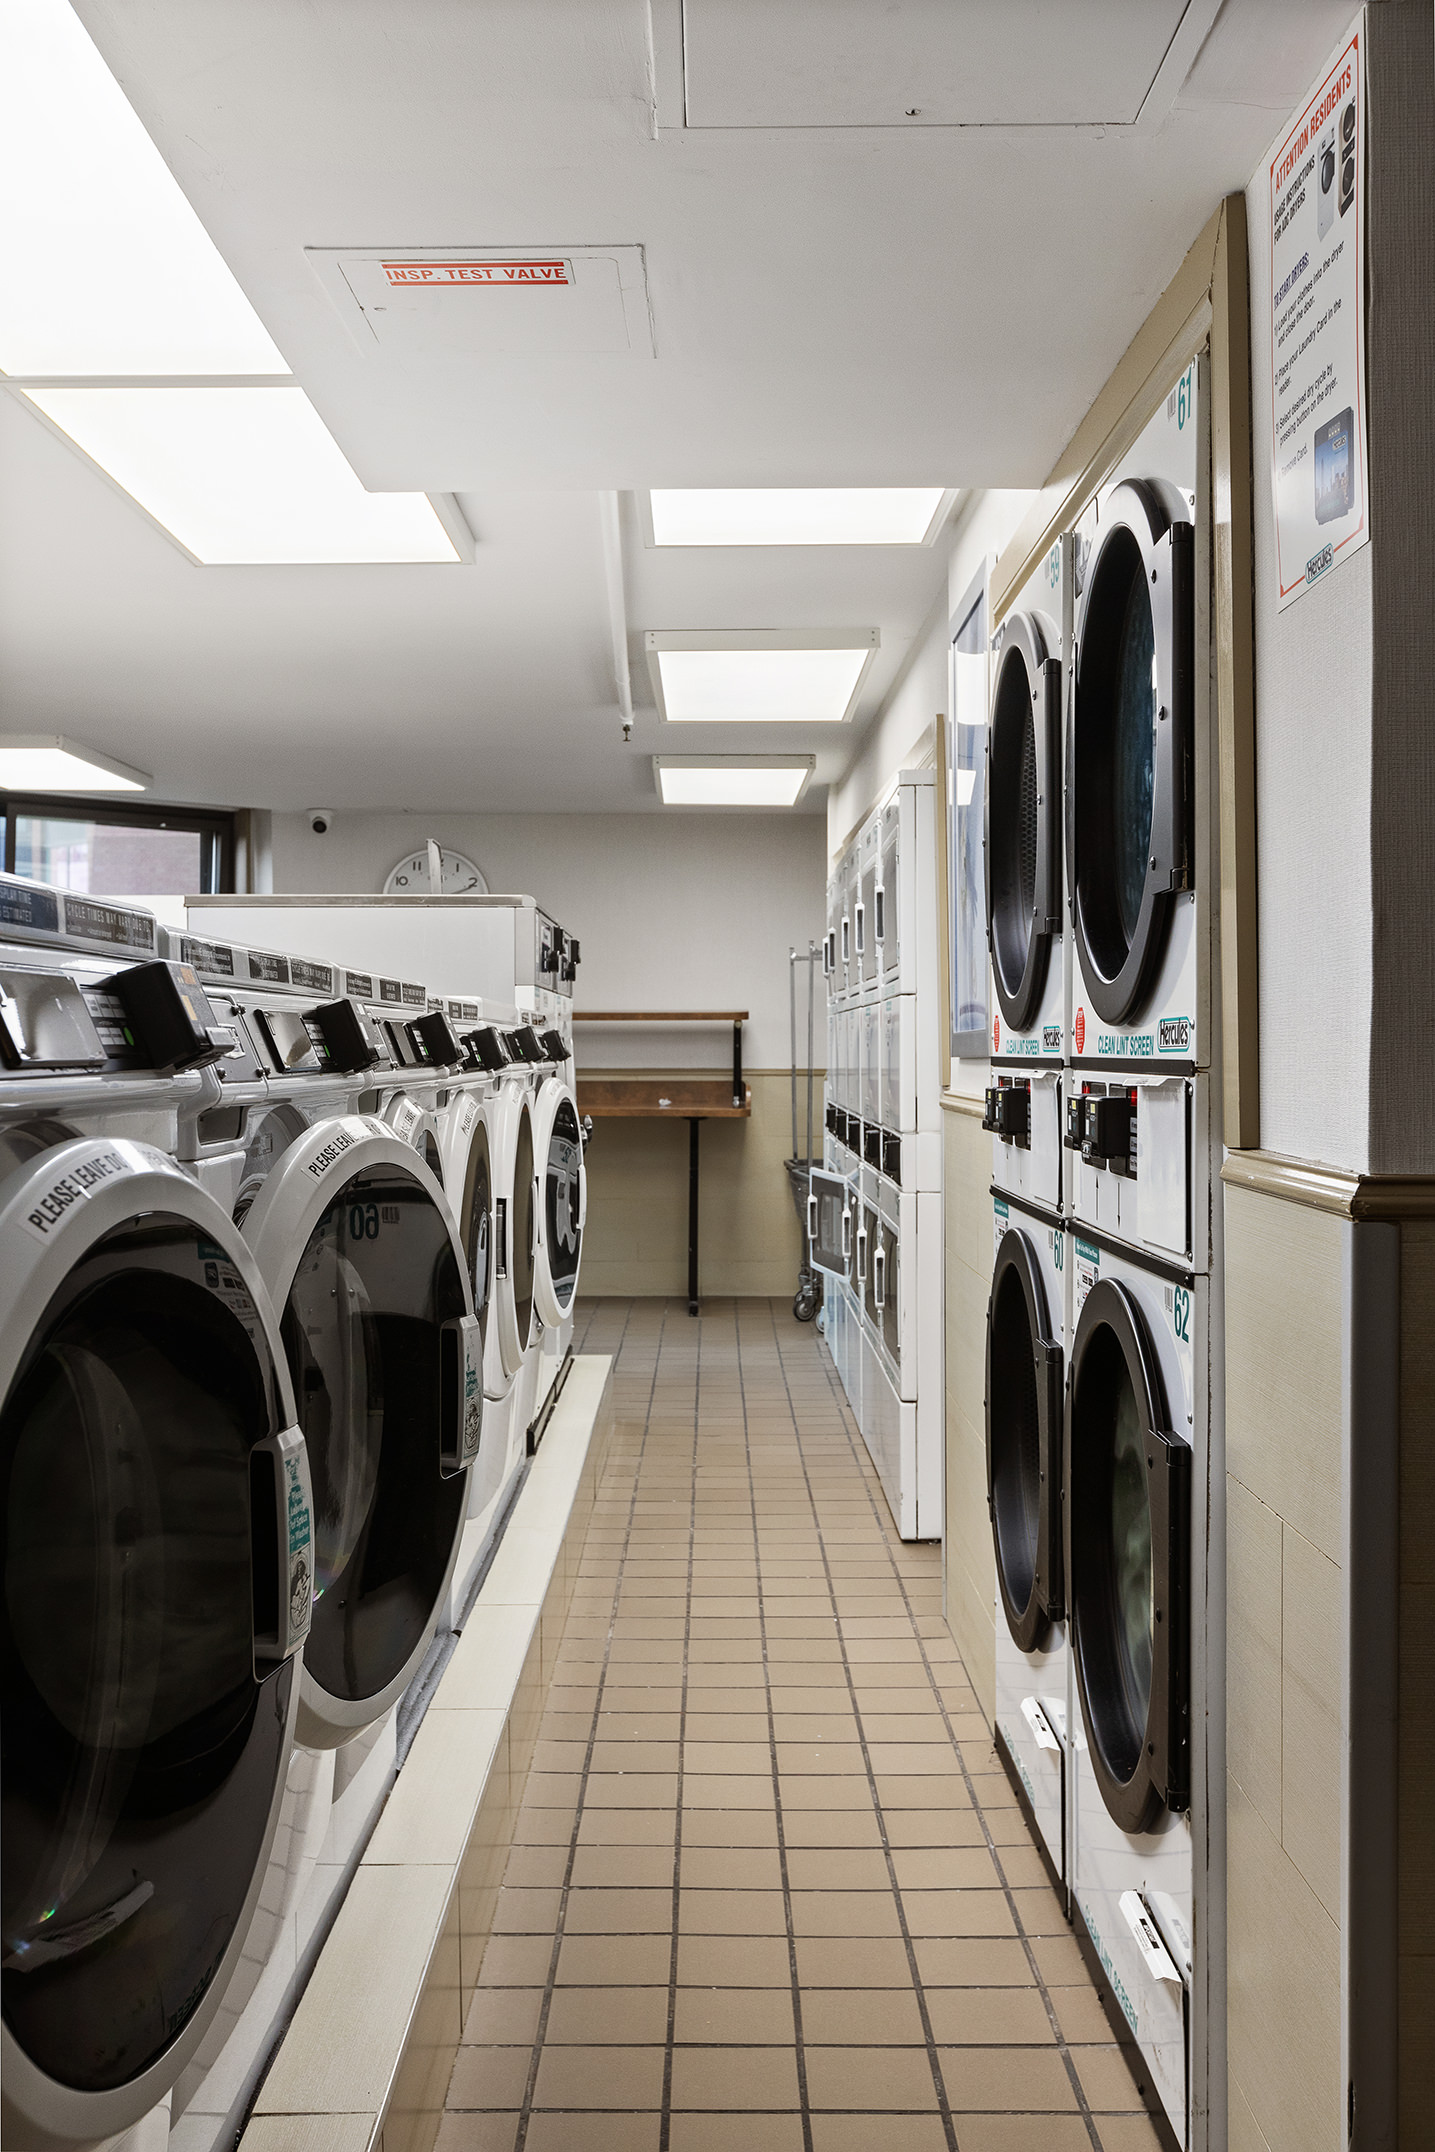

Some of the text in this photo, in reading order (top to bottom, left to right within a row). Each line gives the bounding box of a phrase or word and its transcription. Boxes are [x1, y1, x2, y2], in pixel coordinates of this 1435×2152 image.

[1276, 64, 1351, 194] ATTENTION RESIDENTS
[1274, 154, 1315, 226] USAGE INSTRUCTIONS
[1290, 188, 1305, 220] DRYERS
[385, 268, 566, 280] INSP. TEST VALVE
[1278, 312, 1287, 331] Load
[1287, 300, 1296, 321] your
[1297, 280, 1313, 305] clothes
[1313, 268, 1322, 285] into
[1331, 241, 1344, 263] dryer
[1279, 274, 1291, 302] START
[1279, 362, 1289, 377] Place
[1288, 349, 1298, 370] your
[1298, 328, 1316, 355] Laundry
[1316, 312, 1327, 333] Card
[1328, 308, 1333, 320] in
[1333, 299, 1342, 314] the
[1285, 318, 1296, 338] close
[1178, 366, 1191, 430] 61
[1279, 409, 1290, 429] Select
[1292, 390, 1306, 415] desired
[1315, 370, 1326, 390] cycle
[1327, 363, 1333, 376] by
[1280, 377, 1338, 446] pressing button on the dryer.
[1307, 546, 1332, 579] Hercules
[396, 876, 408, 886] 10
[412, 861, 421, 871] 11
[456, 863, 460, 872] 1
[468, 877, 478, 889] 2
[87, 908, 105, 923] TIMES
[1044, 1028, 1059, 1048] Hercules
[1098, 1036, 1154, 1056] CLEAN LINT SCREEN
[1160, 1019, 1188, 1046] Hercules
[308, 1144, 340, 1177] PLEASE
[28, 1179, 82, 1233] PLEASE
[69, 1155, 114, 1192] LEAVE
[1054, 1230, 1064, 1271] 60
[1174, 1285, 1189, 1343] 62
